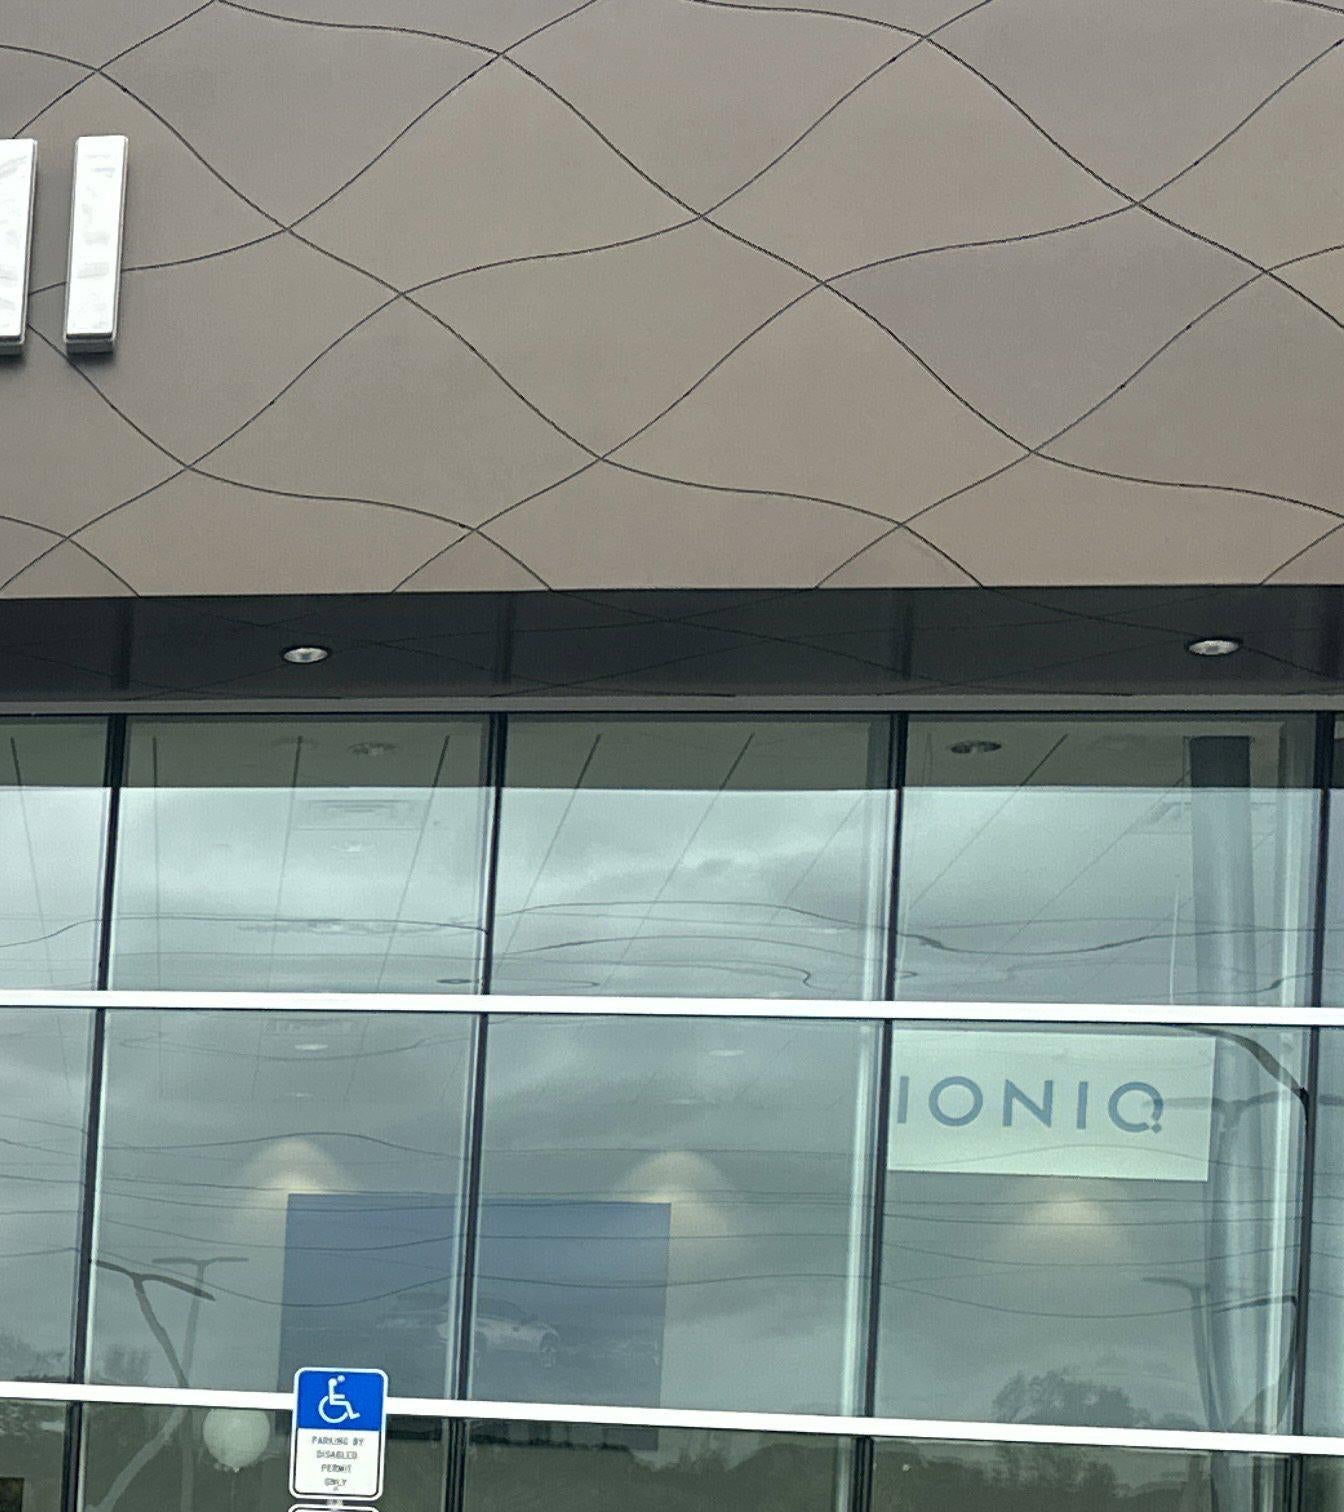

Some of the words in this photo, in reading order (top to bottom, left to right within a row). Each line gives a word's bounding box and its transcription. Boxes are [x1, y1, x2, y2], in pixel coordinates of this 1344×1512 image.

[896, 1075, 1164, 1134] IONIQ
[311, 1436, 349, 1446] PARKING
[352, 1437, 364, 1447] BY
[316, 1450, 358, 1460] DISABLED
[320, 1463, 353, 1473] PERMIT
[323, 1477, 347, 1487] ONLY
